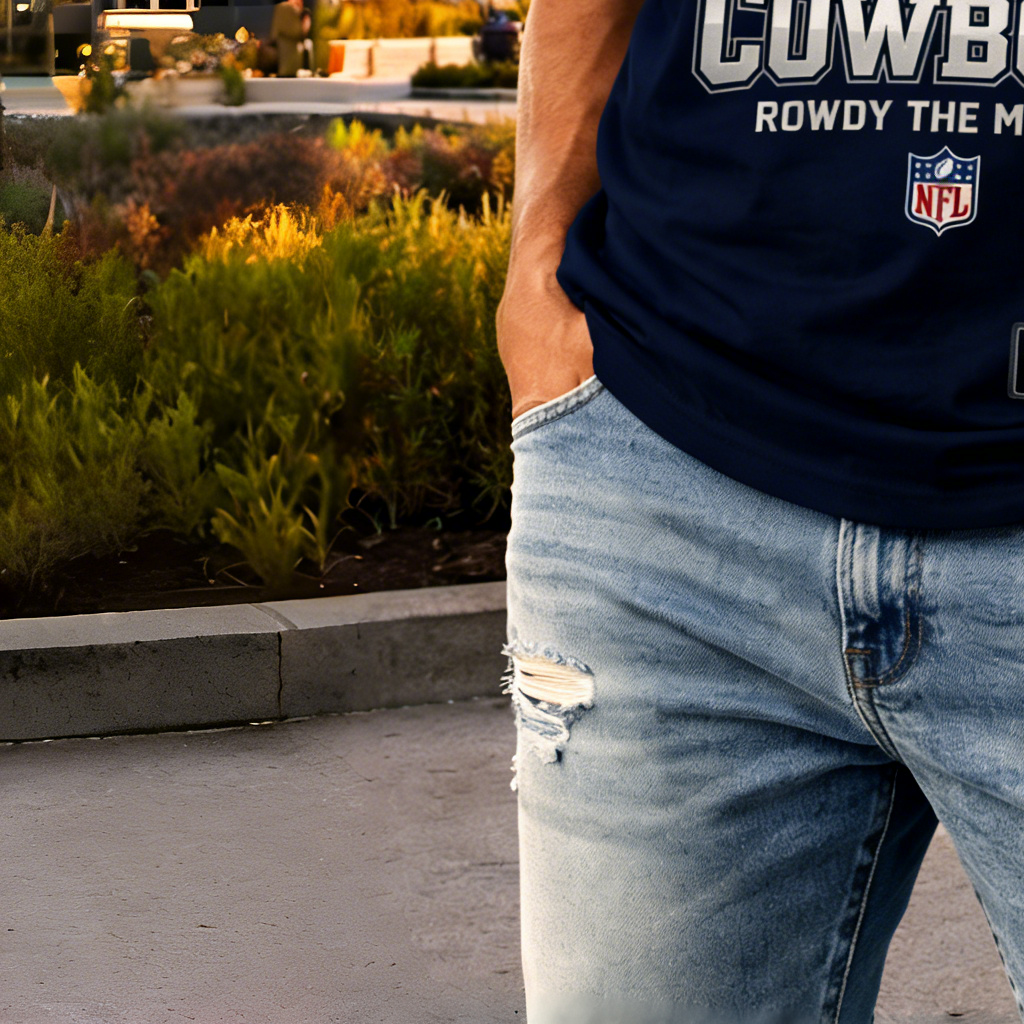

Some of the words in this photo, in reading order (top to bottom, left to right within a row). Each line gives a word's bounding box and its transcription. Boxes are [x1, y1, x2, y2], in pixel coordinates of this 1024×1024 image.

[755, 99, 893, 133] ROWDY
[907, 100, 980, 134] THE
[914, 183, 969, 223] NFL
